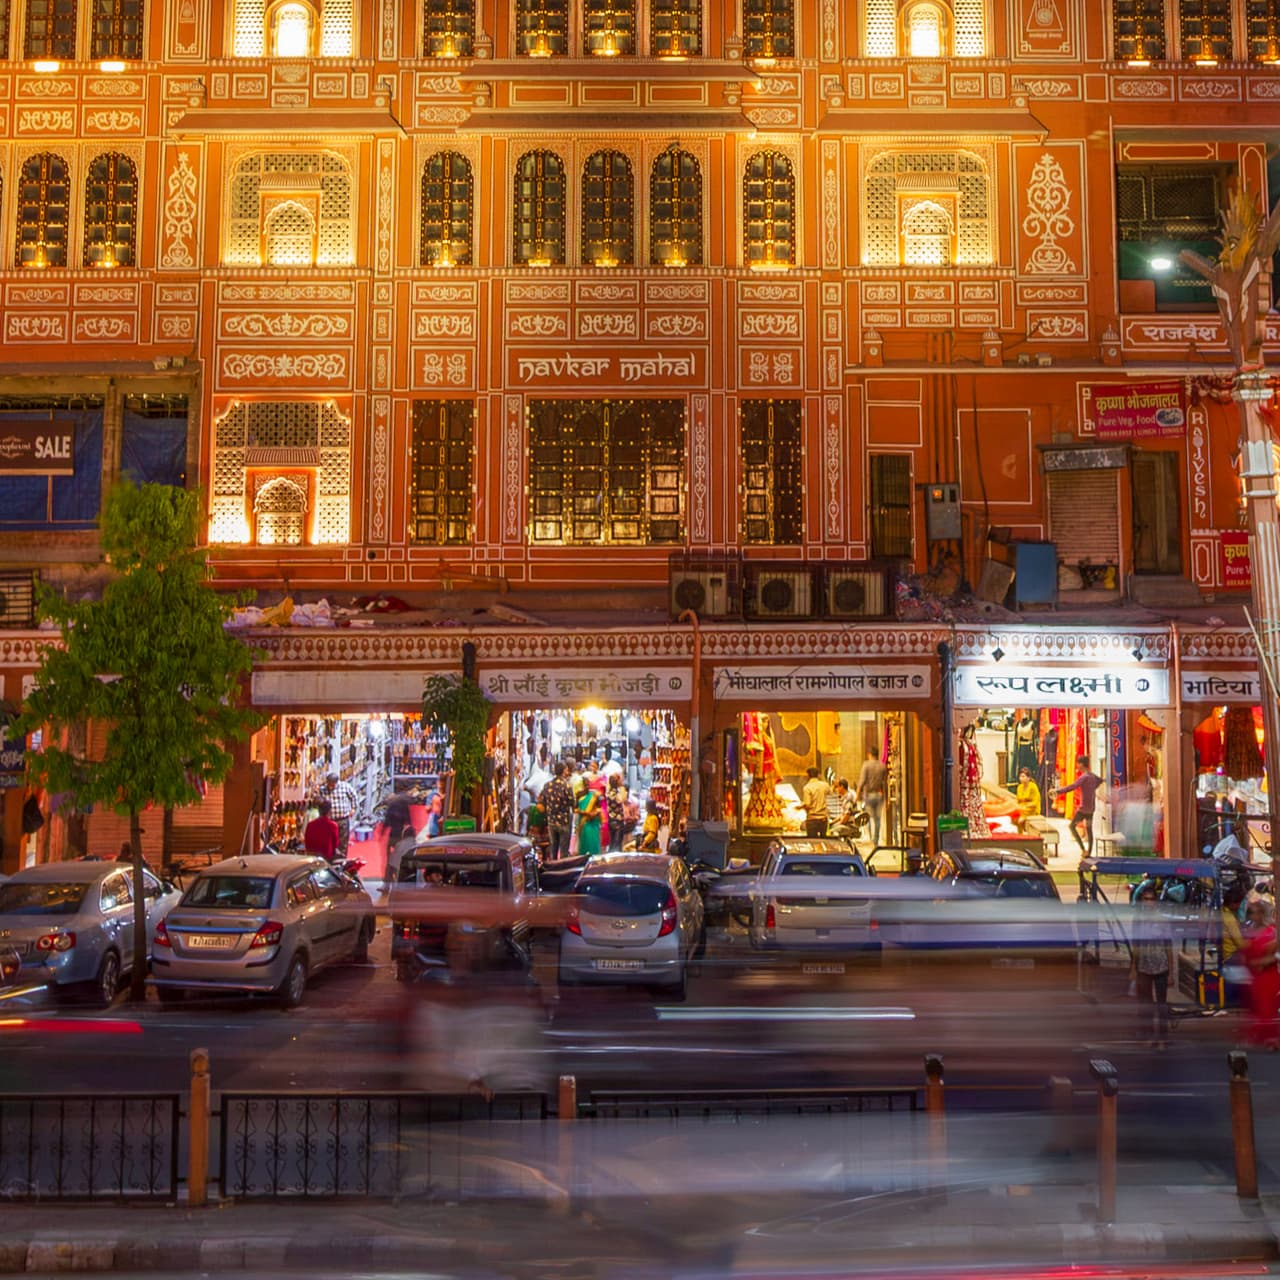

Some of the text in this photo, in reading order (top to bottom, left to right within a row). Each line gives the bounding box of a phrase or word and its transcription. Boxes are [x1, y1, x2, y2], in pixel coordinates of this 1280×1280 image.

[1142, 323, 1217, 341] राजवेश
[518, 352, 696, 383] navkar mahal
[1098, 417, 1117, 427] Pure
[1136, 415, 1156, 425] Food
[34, 435, 71, 459] SALE
[1225, 565, 1245, 576] Pure
[488, 676, 510, 695] श्री
[795, 672, 865, 691] रामगोपाल
[867, 674, 910, 690] बजाज
[1184, 676, 1253, 696] भाटिया
